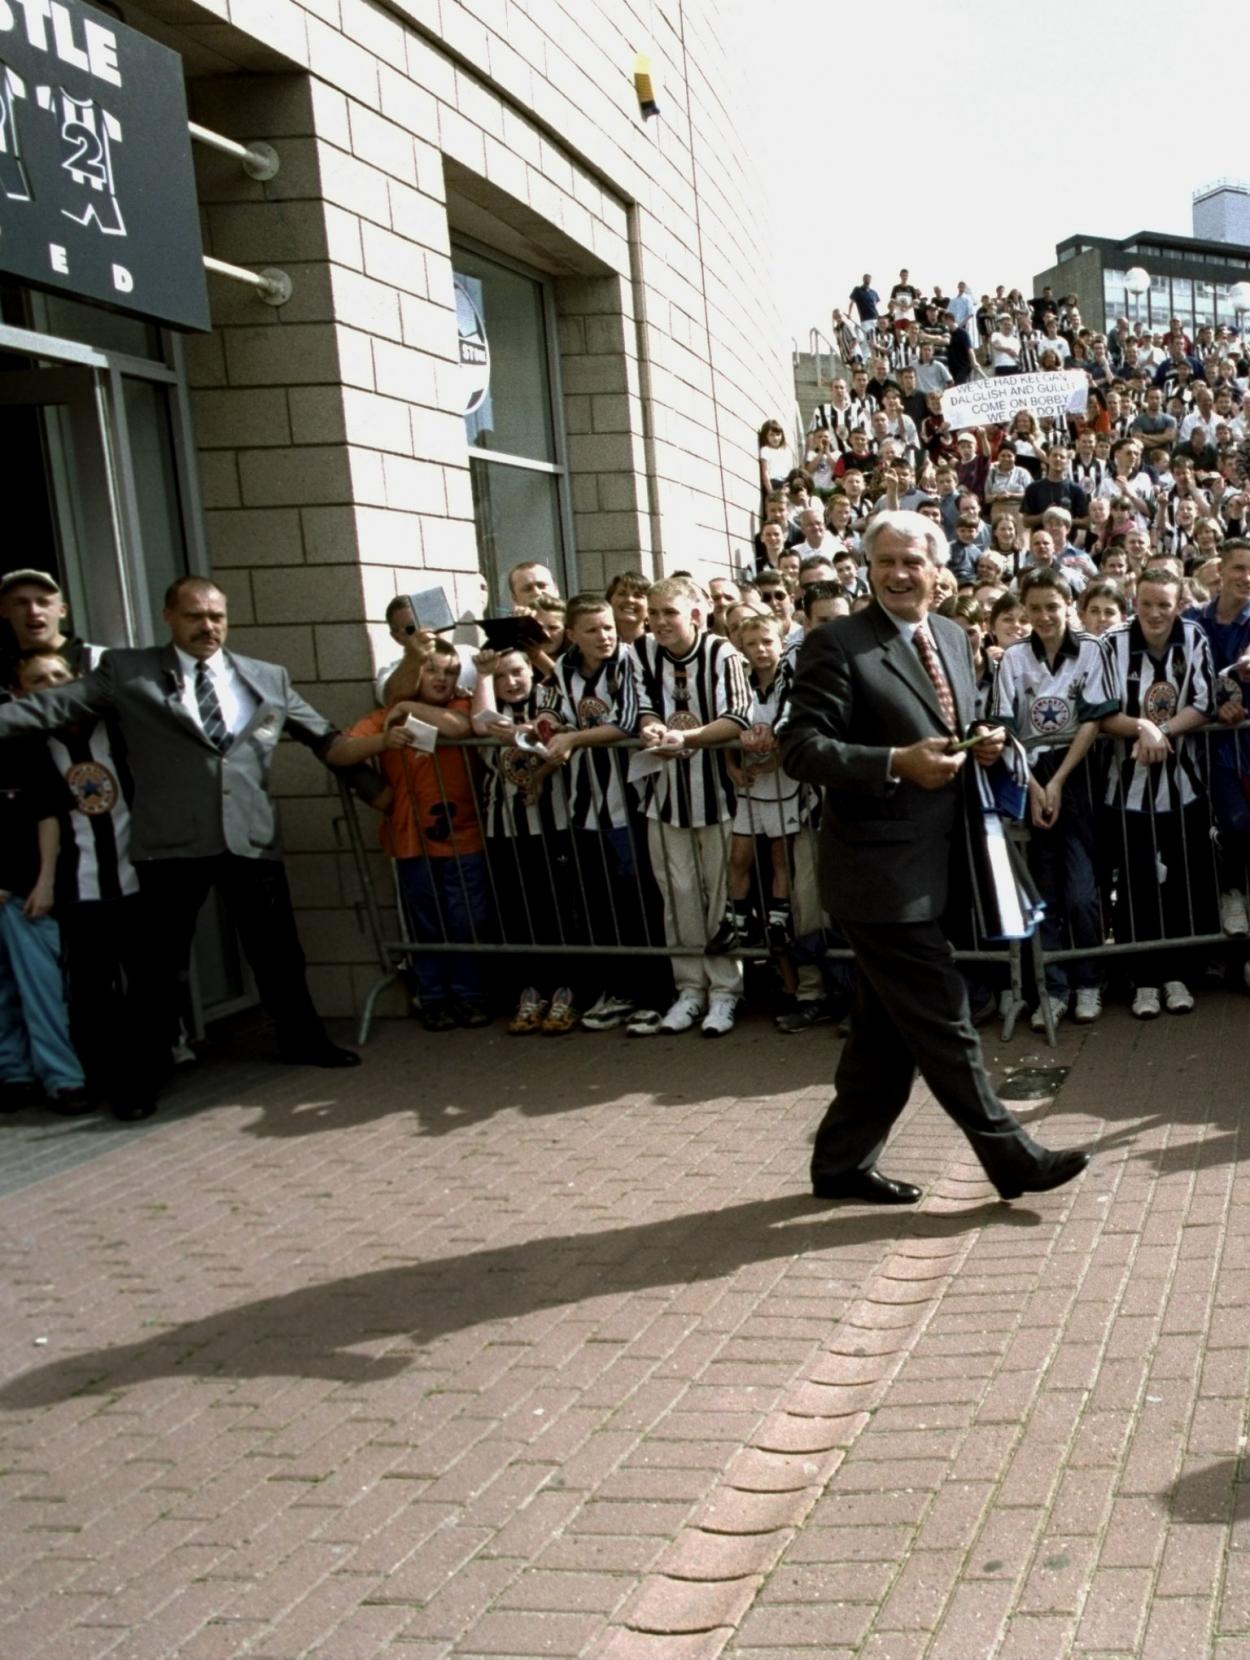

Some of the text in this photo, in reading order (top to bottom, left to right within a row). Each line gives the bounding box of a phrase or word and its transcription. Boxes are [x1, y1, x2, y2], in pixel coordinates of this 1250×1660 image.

[994, 376, 1017, 387] HAD
[950, 389, 1007, 406] DALGLISH
[1010, 384, 1034, 396] AND
[971, 400, 1006, 415] COME
[1010, 398, 1027, 409] ON
[1030, 394, 1068, 406] BOBBY
[987, 411, 1006, 422] WE
[1037, 406, 1054, 416] DO
[1057, 404, 1067, 414] IT
